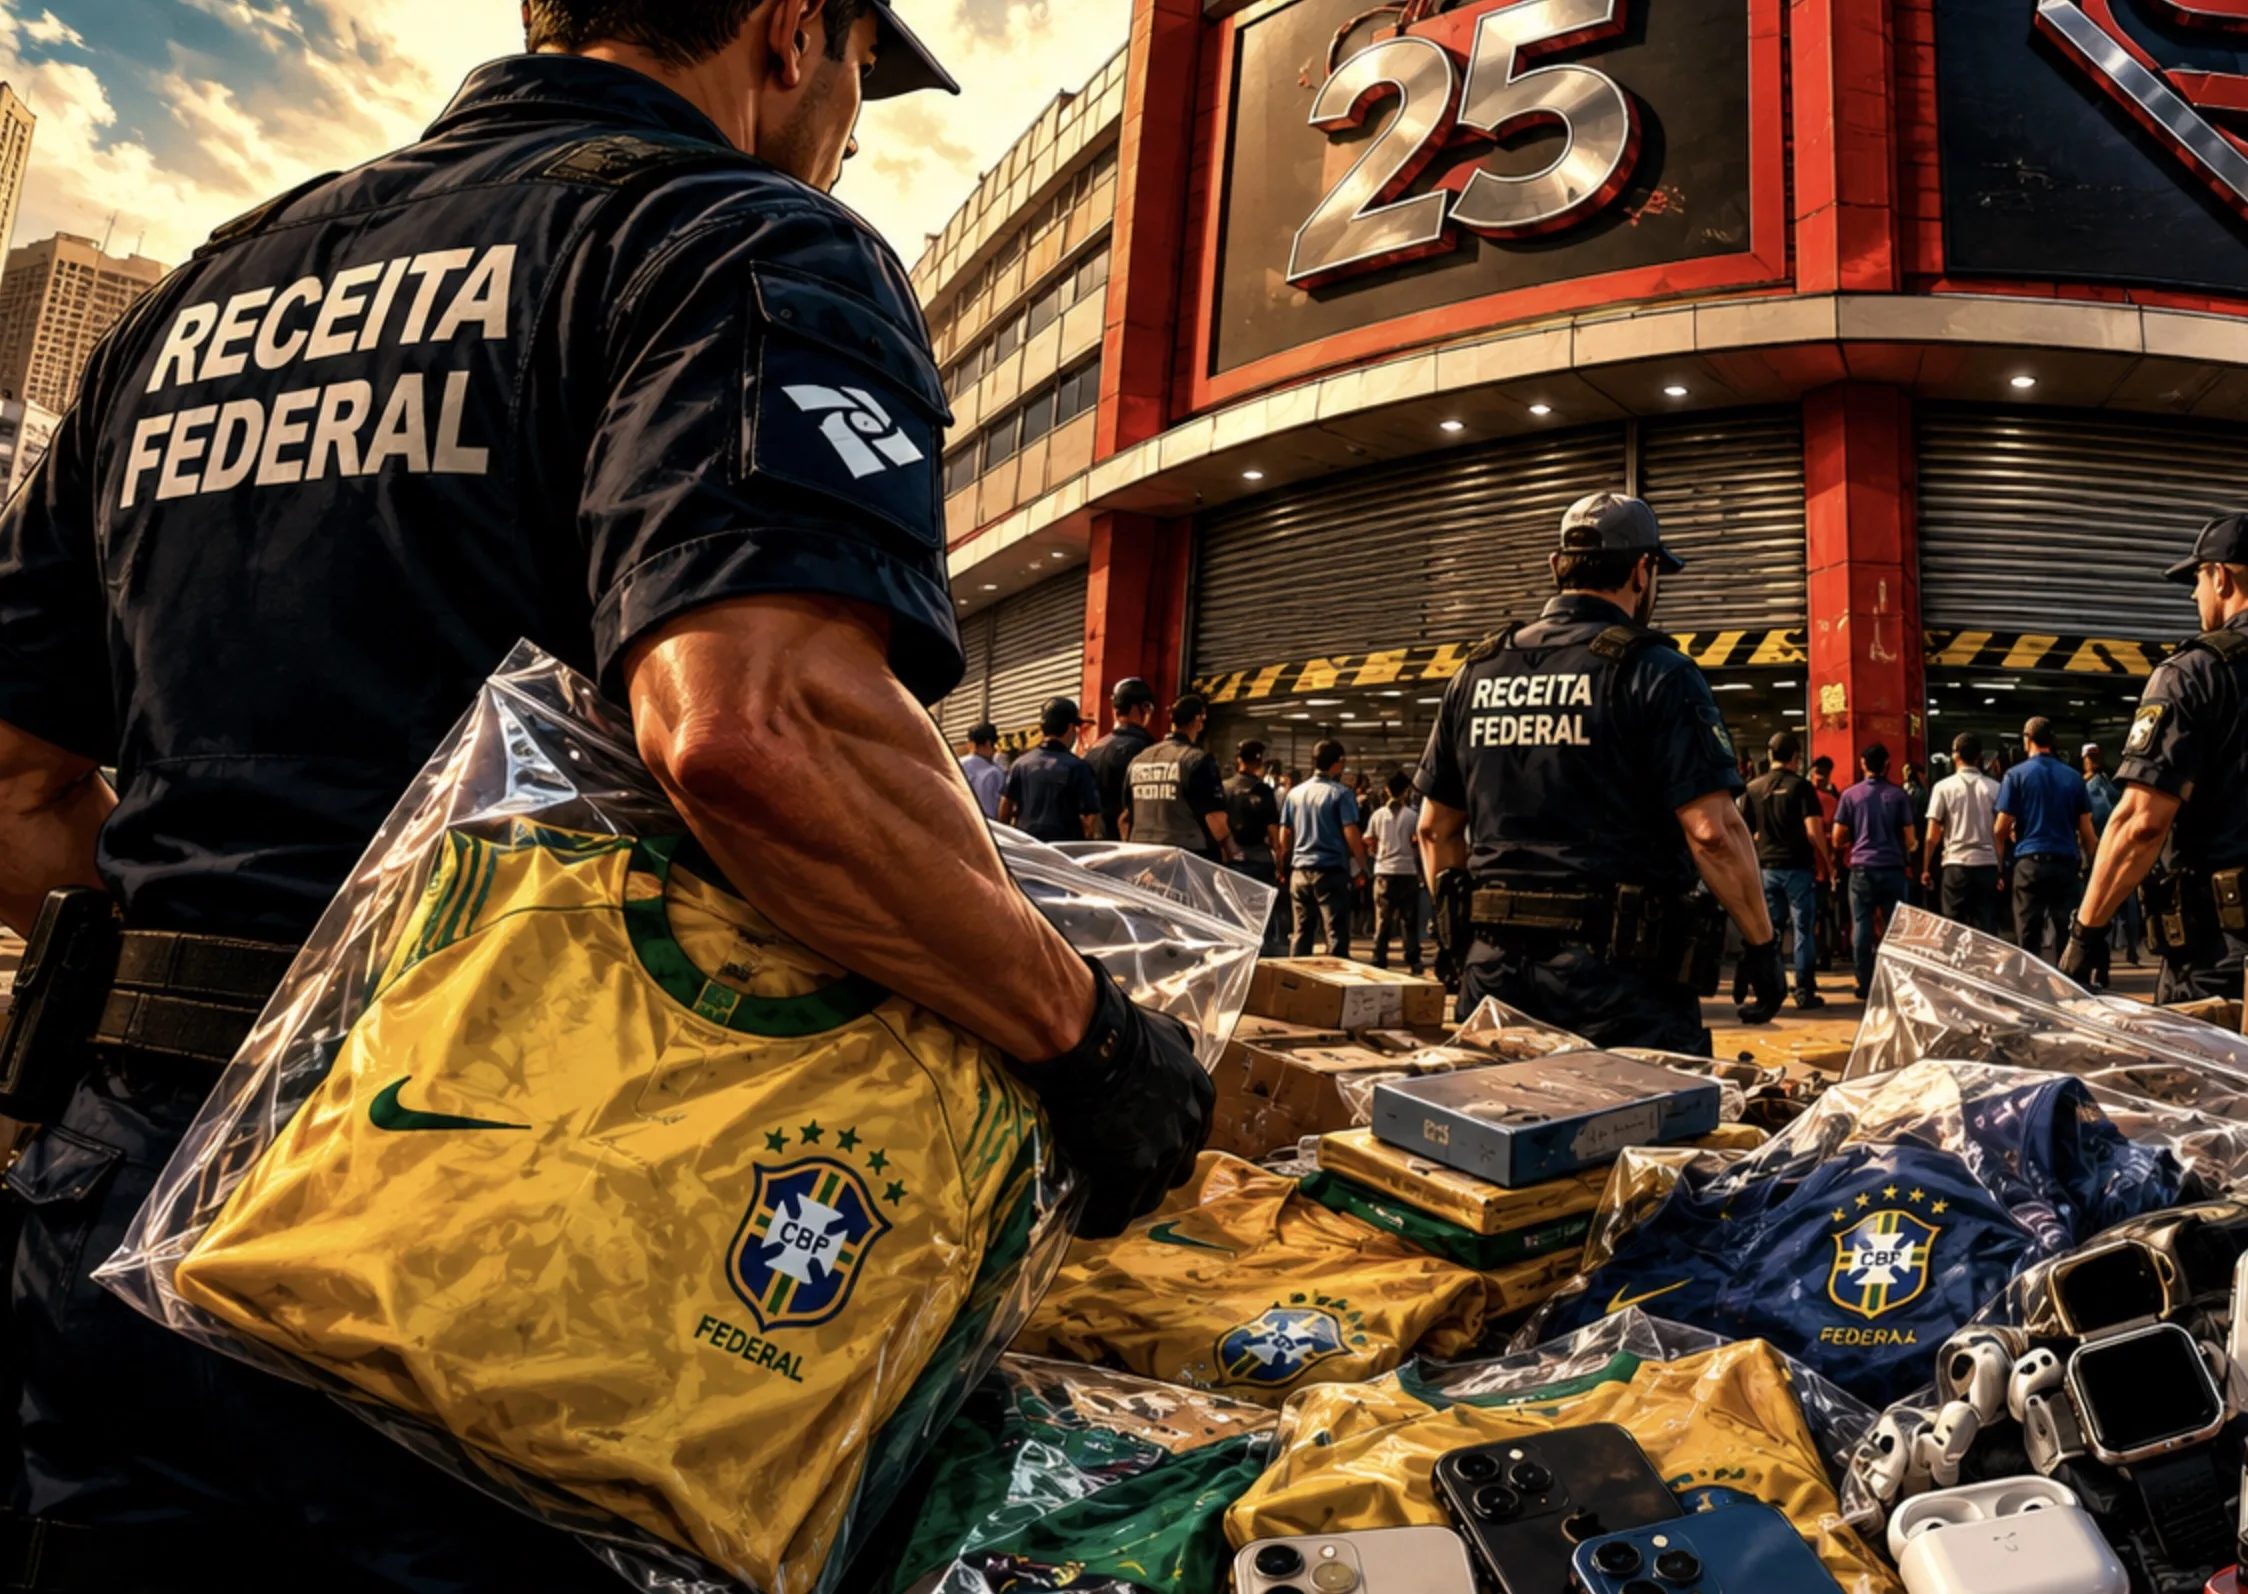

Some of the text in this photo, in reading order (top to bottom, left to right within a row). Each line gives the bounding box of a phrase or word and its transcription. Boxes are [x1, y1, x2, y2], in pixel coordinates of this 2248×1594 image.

[1286, 0, 1632, 284] 25
[146, 244, 518, 394] RECEITA
[119, 371, 489, 510] FEDERAL
[1471, 673, 1593, 710] RECEITA
[1469, 714, 1591, 748] FEDERAL
[694, 1314, 806, 1384] FEDERAL
[1820, 1326, 1918, 1347] FEDERAL
